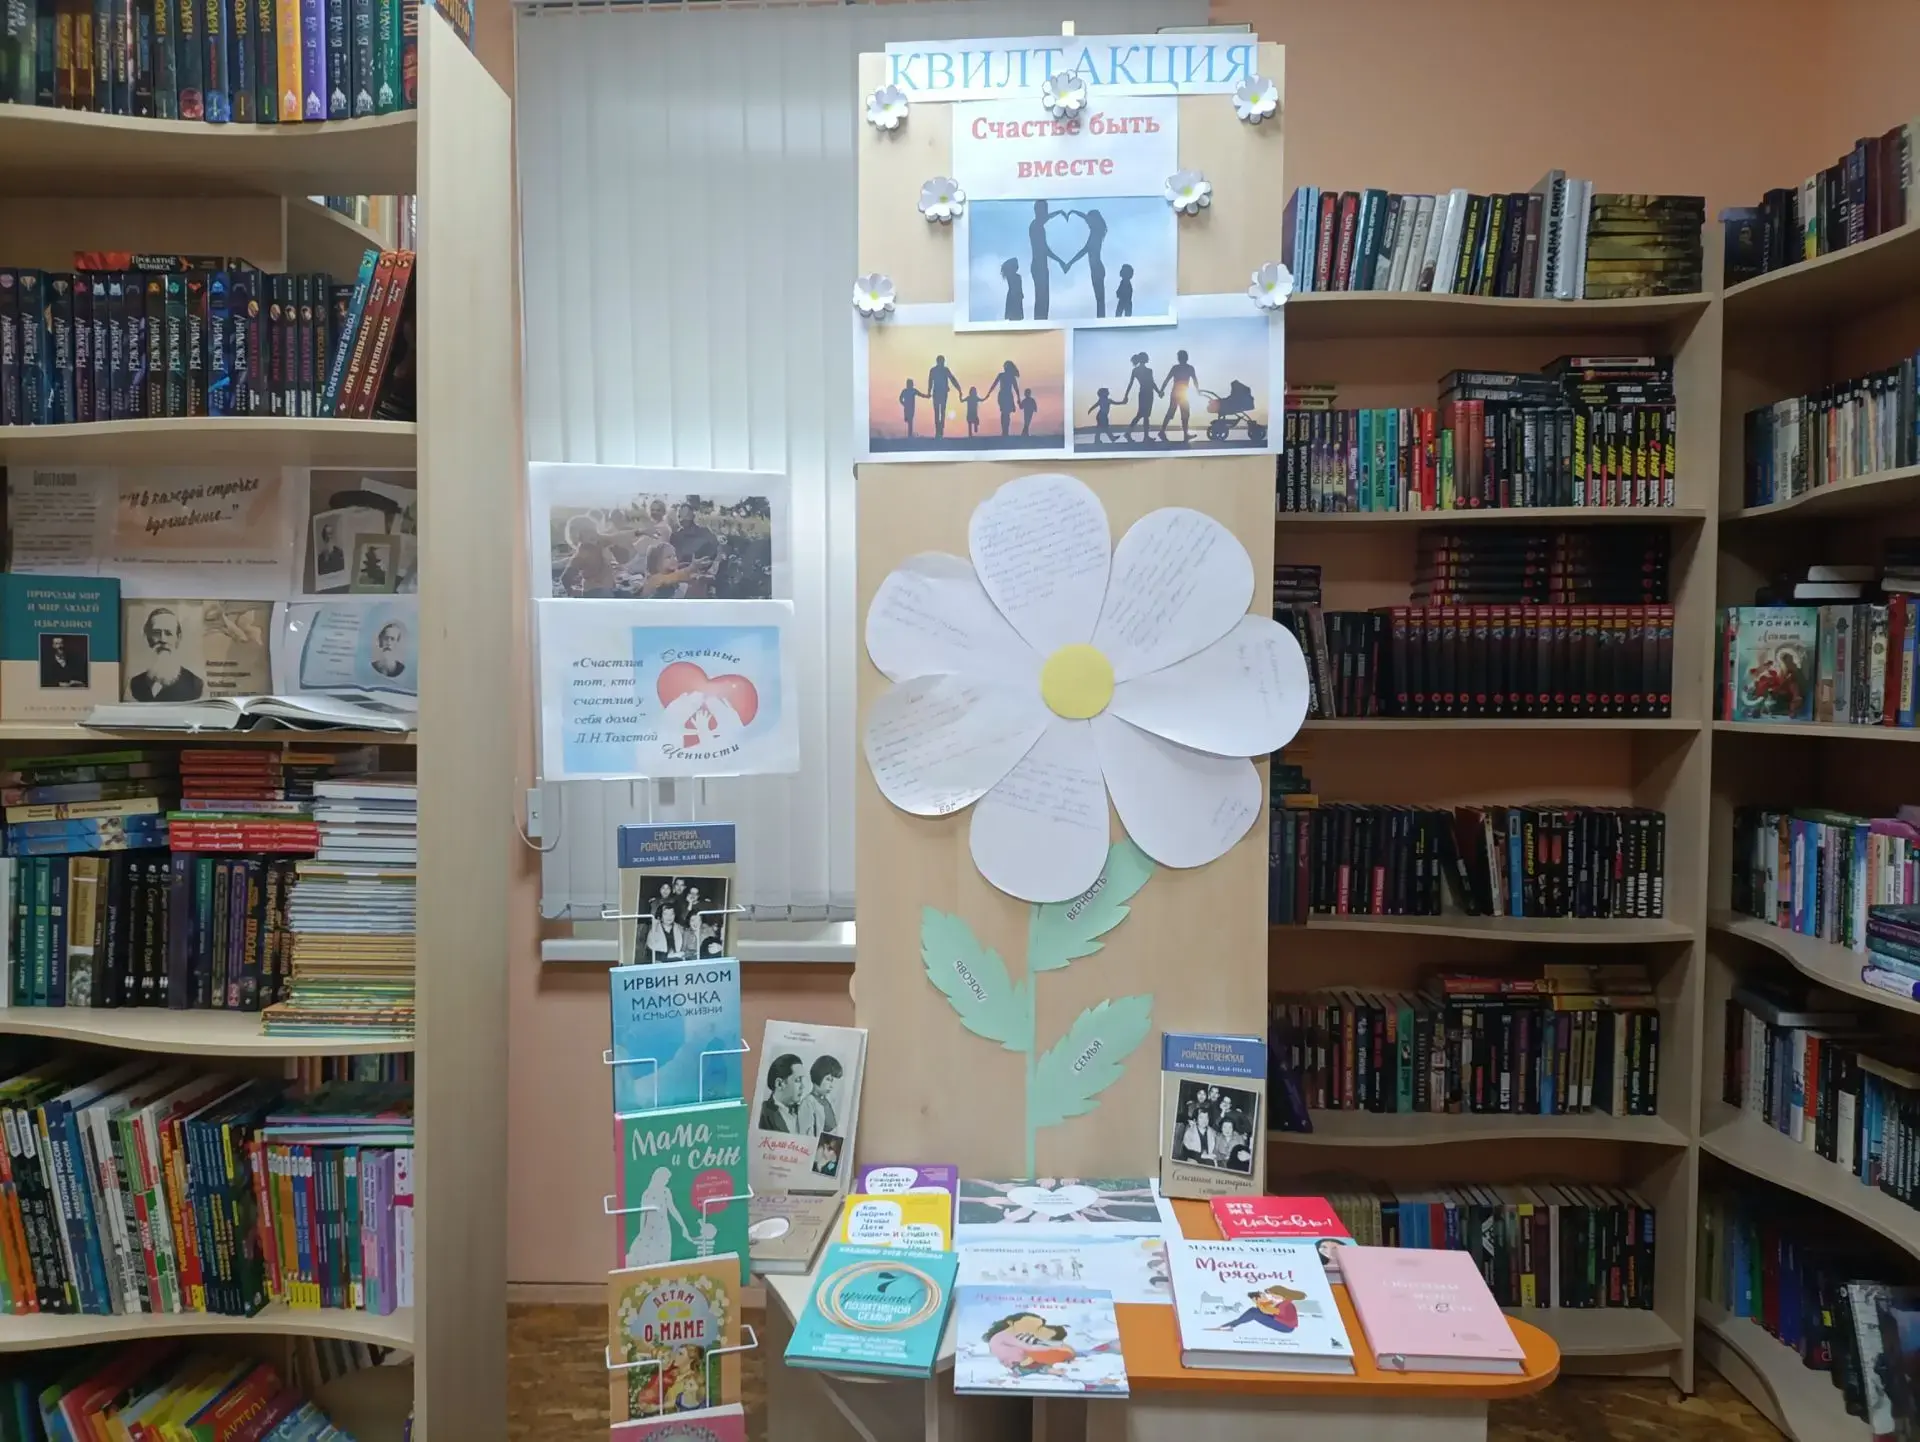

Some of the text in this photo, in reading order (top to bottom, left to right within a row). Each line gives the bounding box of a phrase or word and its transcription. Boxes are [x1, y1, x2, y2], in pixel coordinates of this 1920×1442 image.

[972, 111, 1160, 141] Счастье быть
[1017, 157, 1114, 178] вместе
[1545, 177, 1563, 293] БЛОКАДНАЯ КНИГА
[345, 373, 355, 394] МИР
[362, 374, 373, 395] МИР
[79, 592, 101, 600] МИР
[38, 604, 60, 612] МИР
[1749, 619, 1810, 627] ТРОНИНА
[660, 648, 741, 665] Семейные
[573, 677, 636, 688] тот, кто
[573, 696, 644, 707] счастлив у
[574, 714, 602, 724] себя
[655, 831, 699, 841] ЕКАТЕРИНА
[640, 839, 712, 852] РОЖДЕСТВЕНСКАЯ
[1066, 876, 1108, 921] ВЕРНОСТЬ
[624, 970, 732, 991] ИРВИН ЯЛОМ
[955, 960, 987, 1002] ЛЮБОВЬ
[632, 990, 721, 1010] МАМОЧКА
[632, 1006, 723, 1022] И СМЫСЛ ЖИЗНИ
[1193, 1041, 1233, 1053] ЕКАТЕРИНА
[1073, 1040, 1103, 1073] СЕМЬЯ
[1181, 1051, 1245, 1064] РОЖДЕСТВЕНСКАЯ
[632, 1122, 713, 1161] Мама
[52, 1141, 67, 1174] РОССИИ
[61, 1141, 77, 1174] РОССИИ
[671, 1153, 680, 1167] и
[1195, 1257, 1258, 1272] Мама
[877, 1271, 901, 1293] 7
[1218, 1270, 1294, 1284] рядом!
[653, 1289, 695, 1307] ДЕТЯМ
[844, 1300, 912, 1315] ПОЗИТИВНОЙ
[857, 1312, 893, 1323] СЕМЬИ
[644, 1320, 706, 1342] О МАМЕ
